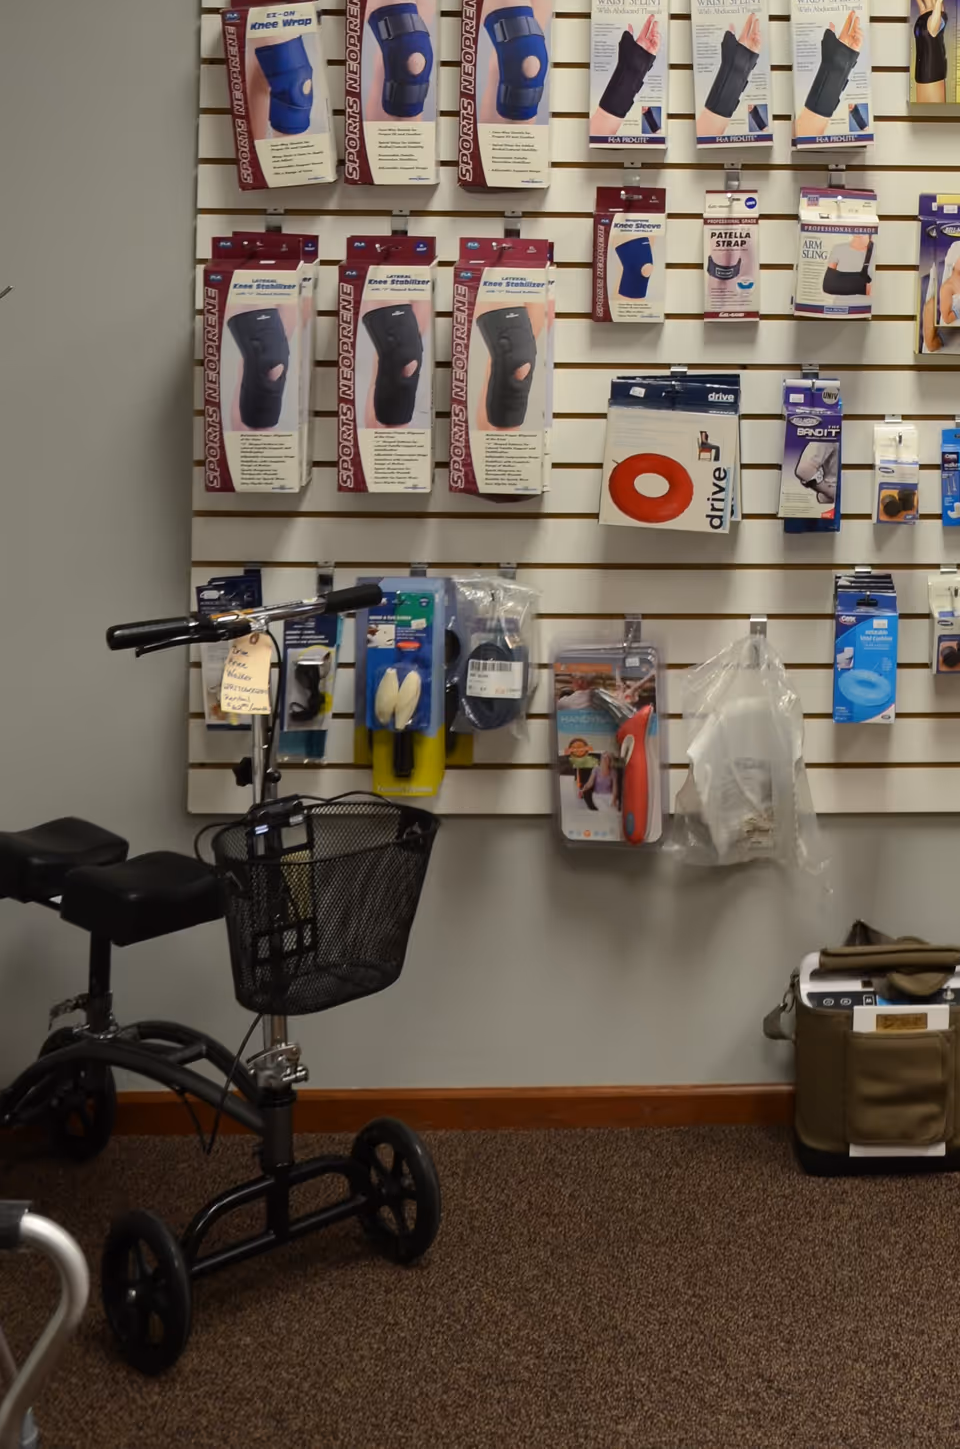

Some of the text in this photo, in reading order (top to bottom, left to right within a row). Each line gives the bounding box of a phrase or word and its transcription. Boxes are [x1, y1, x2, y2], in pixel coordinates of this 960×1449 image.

[250, 18, 312, 31] Knee Wrap
[224, 26, 252, 183] SPORTS NEOPRENE
[345, 97, 359, 180] SPORTS
[458, 98, 474, 181] SPORTS
[802, 240, 822, 250] ARM
[804, 225, 876, 234] PROFESSIONAL GRADE
[802, 249, 827, 260] SLING
[205, 287, 220, 488] SPORTS NEOPRENE
[339, 283, 354, 488] SPORTS NEOPRENE
[451, 284, 468, 489] SPORTS NEOPRENE
[708, 392, 735, 402] drive
[823, 392, 838, 400] UNIV
[797, 428, 840, 436] BANDIT
[706, 467, 728, 530] drive
